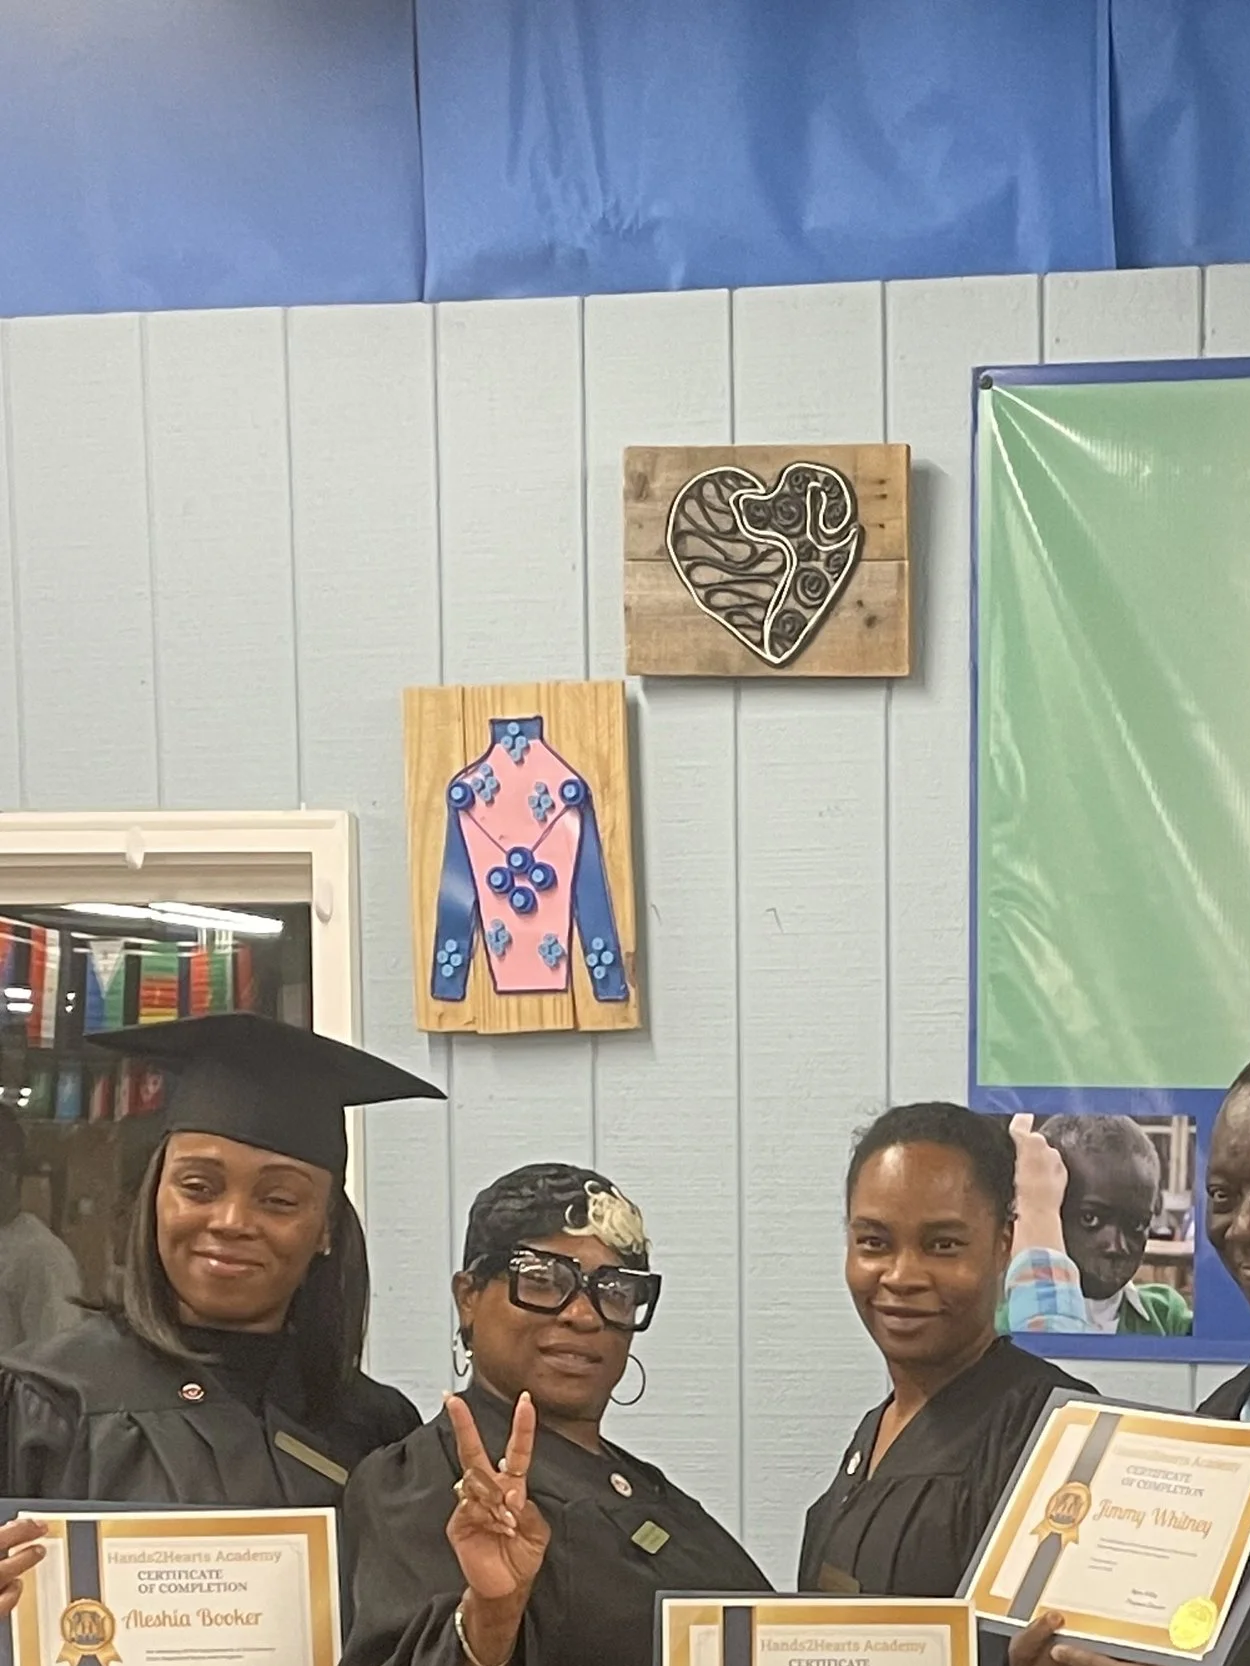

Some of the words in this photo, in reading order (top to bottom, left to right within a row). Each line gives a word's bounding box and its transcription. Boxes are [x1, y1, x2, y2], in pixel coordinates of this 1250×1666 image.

[1126, 1465, 1193, 1483] CERTIFICATE
[1136, 1479, 1205, 1497] COMPLETION
[1092, 1498, 1146, 1529] Jimmy
[1151, 1507, 1213, 1540] Whitney
[107, 1550, 212, 1565] Hands2Hearts
[215, 1549, 283, 1564] Academy
[137, 1569, 224, 1581] CERTIFICATE
[138, 1583, 156, 1594] OF
[158, 1582, 248, 1594] COMPLETION
[122, 1608, 192, 1630] Aleshia
[196, 1607, 263, 1628] Booker
[760, 1638, 860, 1652] Hands2Hearts
[863, 1639, 927, 1655] Academy
